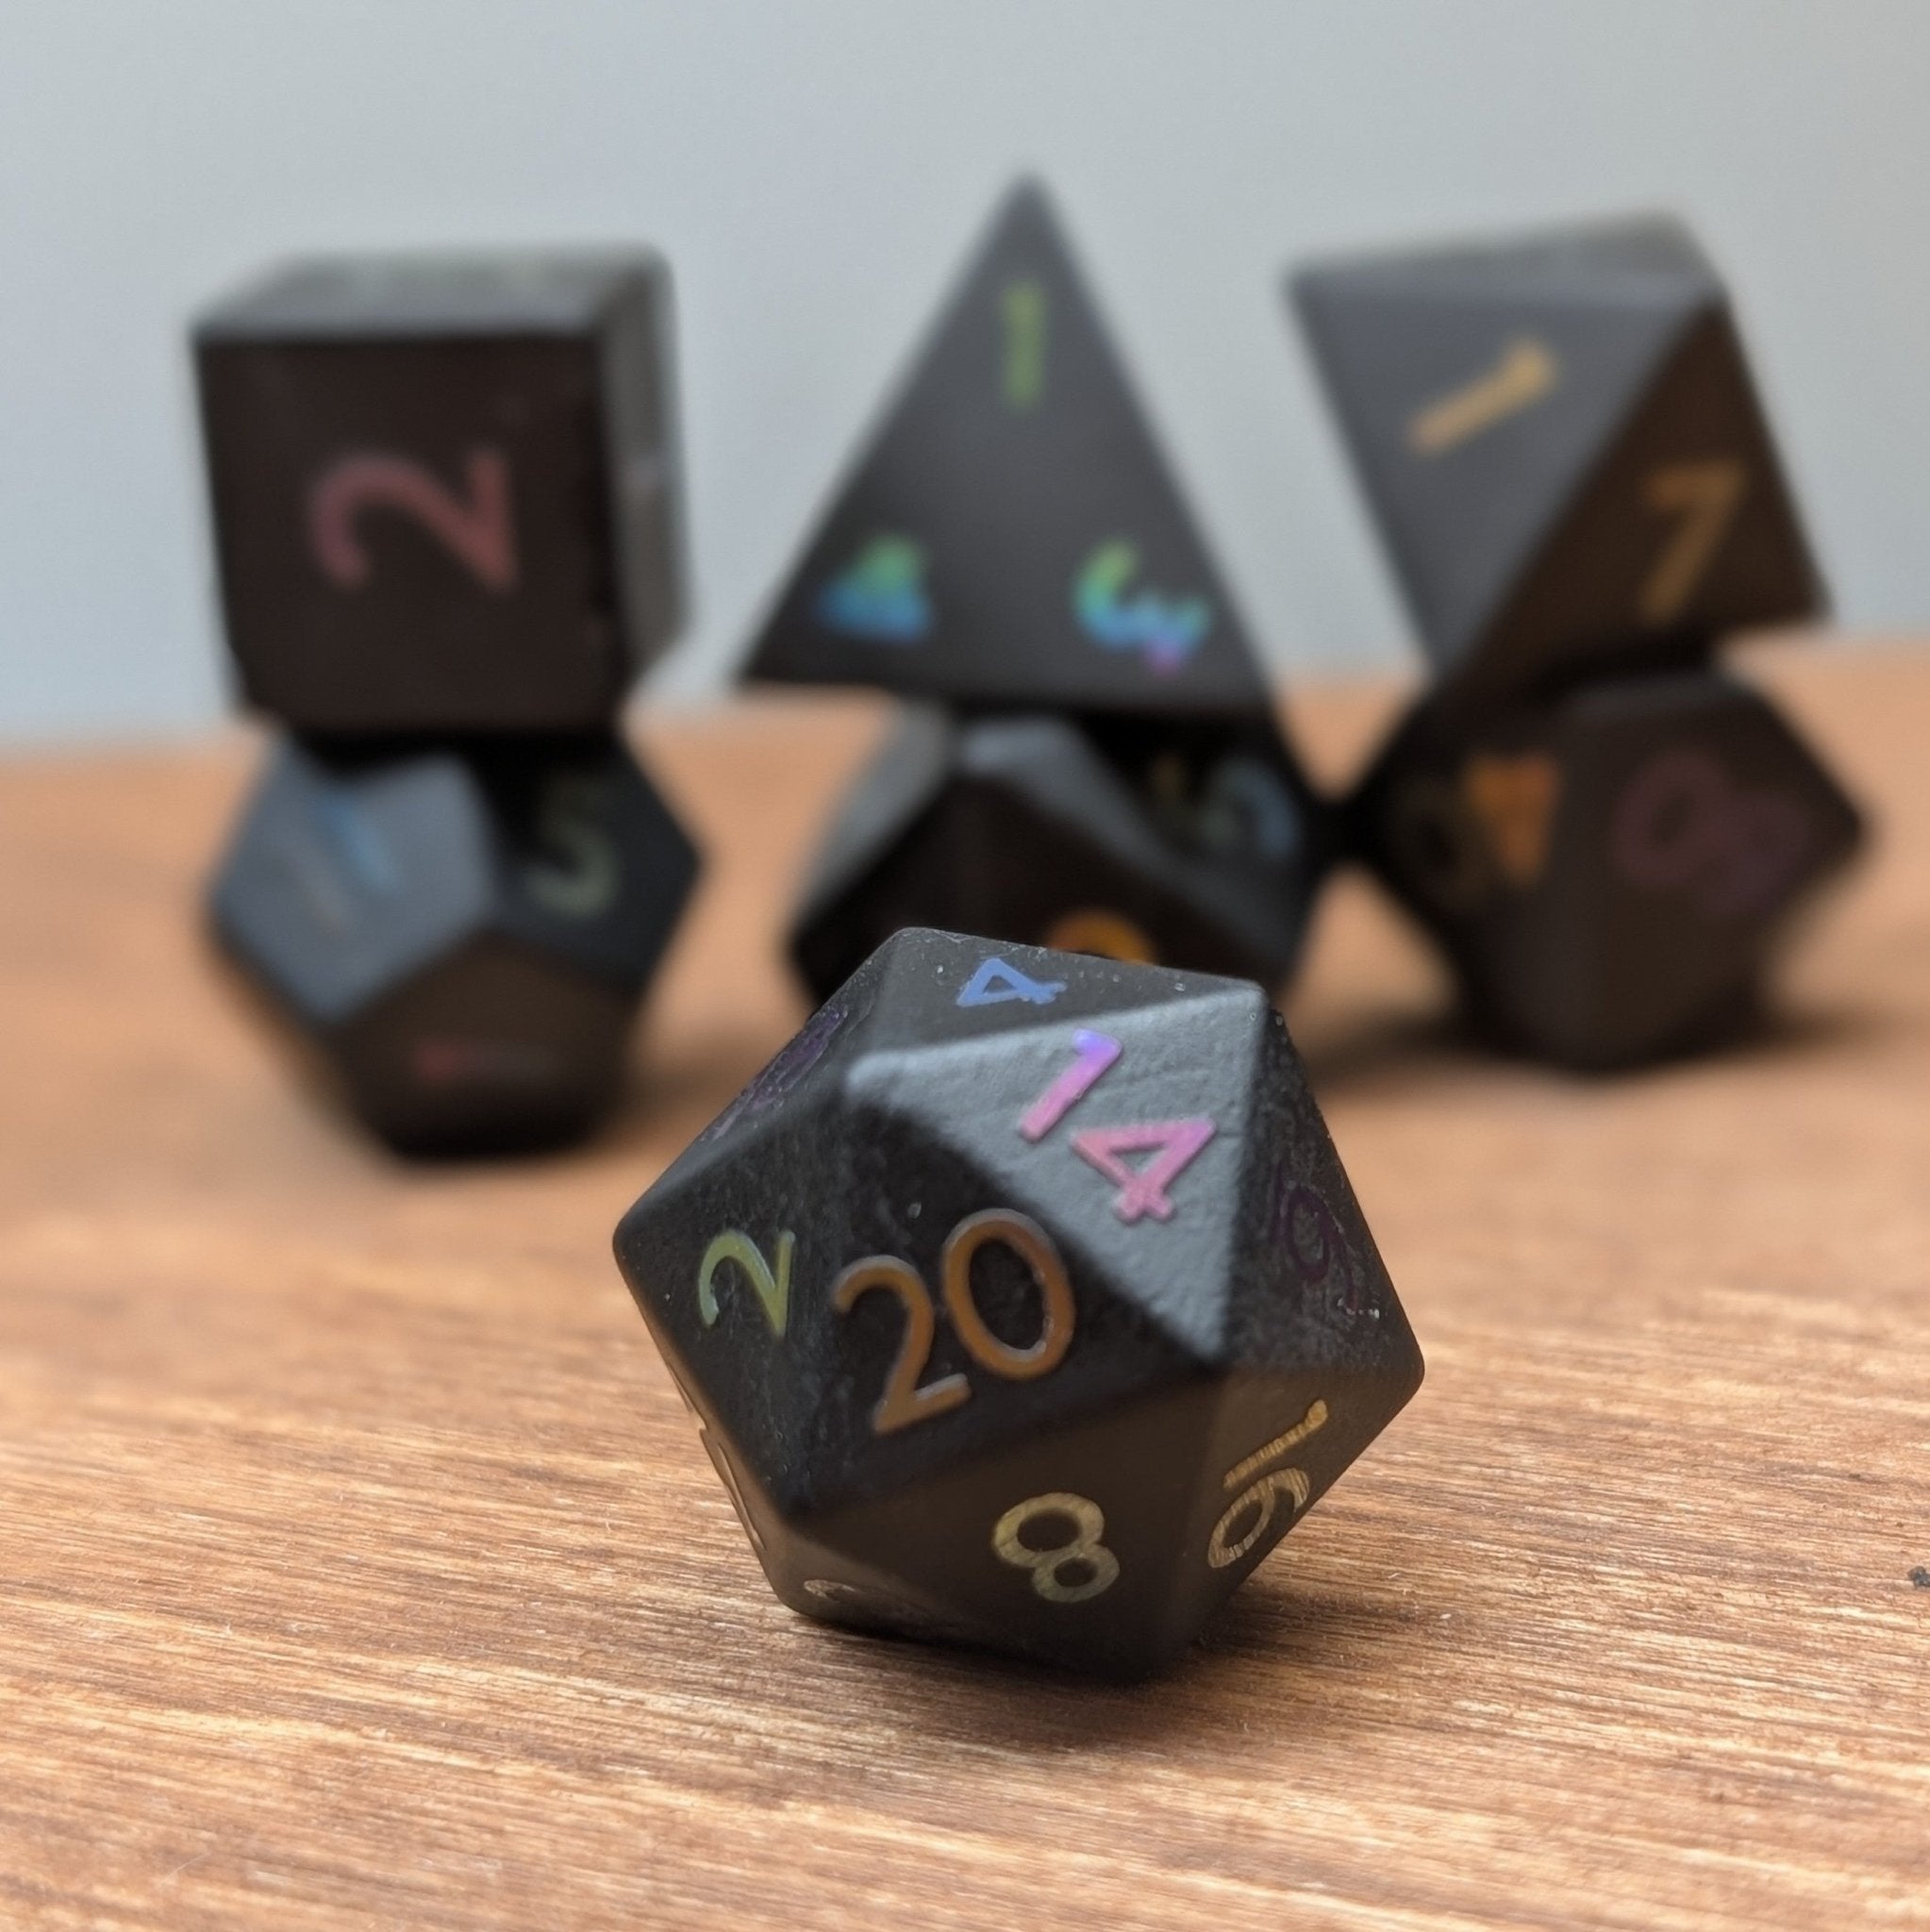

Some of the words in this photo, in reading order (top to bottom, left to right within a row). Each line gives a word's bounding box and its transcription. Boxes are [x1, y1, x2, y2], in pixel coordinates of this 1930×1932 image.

[1000, 281, 1047, 408] 1
[1408, 338, 1561, 457] 1
[308, 447, 518, 591] 2
[1641, 455, 1751, 623] 7
[524, 777, 620, 919] 5
[956, 958, 1065, 1008] 4
[1018, 1029, 1215, 1224] 14
[696, 1228, 797, 1339] 2
[831, 1208, 1076, 1435] 20
[991, 1492, 1120, 1605] 8
[1208, 1400, 1328, 1570] 16
